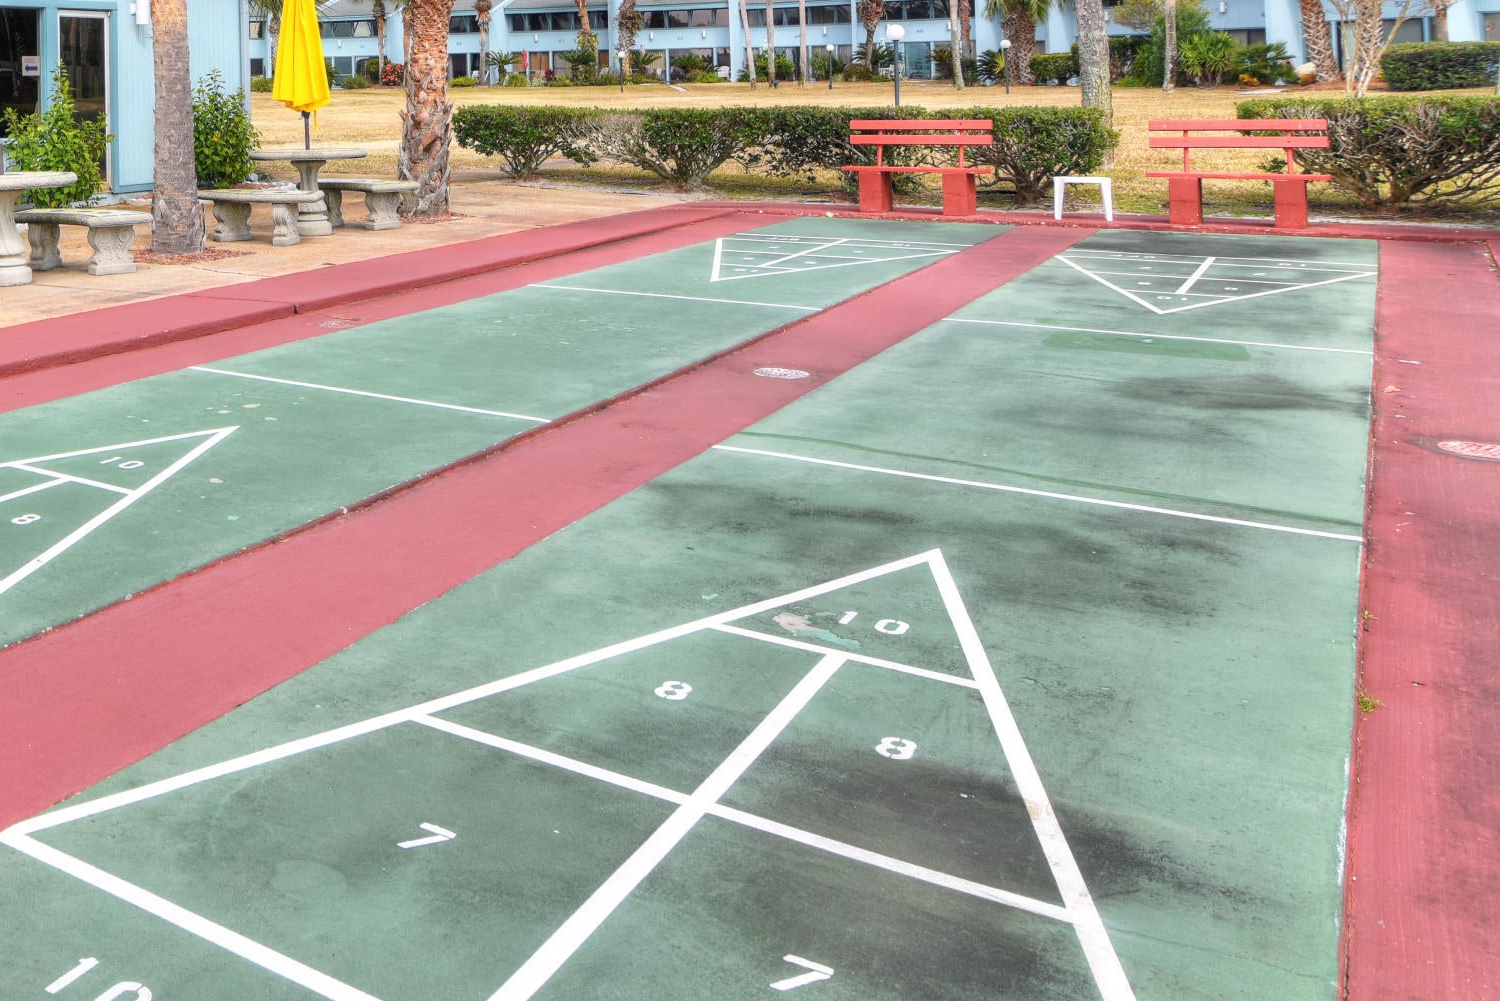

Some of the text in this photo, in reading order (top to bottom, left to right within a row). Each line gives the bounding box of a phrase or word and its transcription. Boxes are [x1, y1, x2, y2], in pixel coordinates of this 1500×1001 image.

[98, 456, 145, 470] 10
[11, 513, 41, 526] 8
[838, 609, 910, 636] 10
[653, 680, 693, 702] 8
[874, 736, 918, 761] 8
[396, 822, 457, 850] 7
[769, 953, 835, 992] 7
